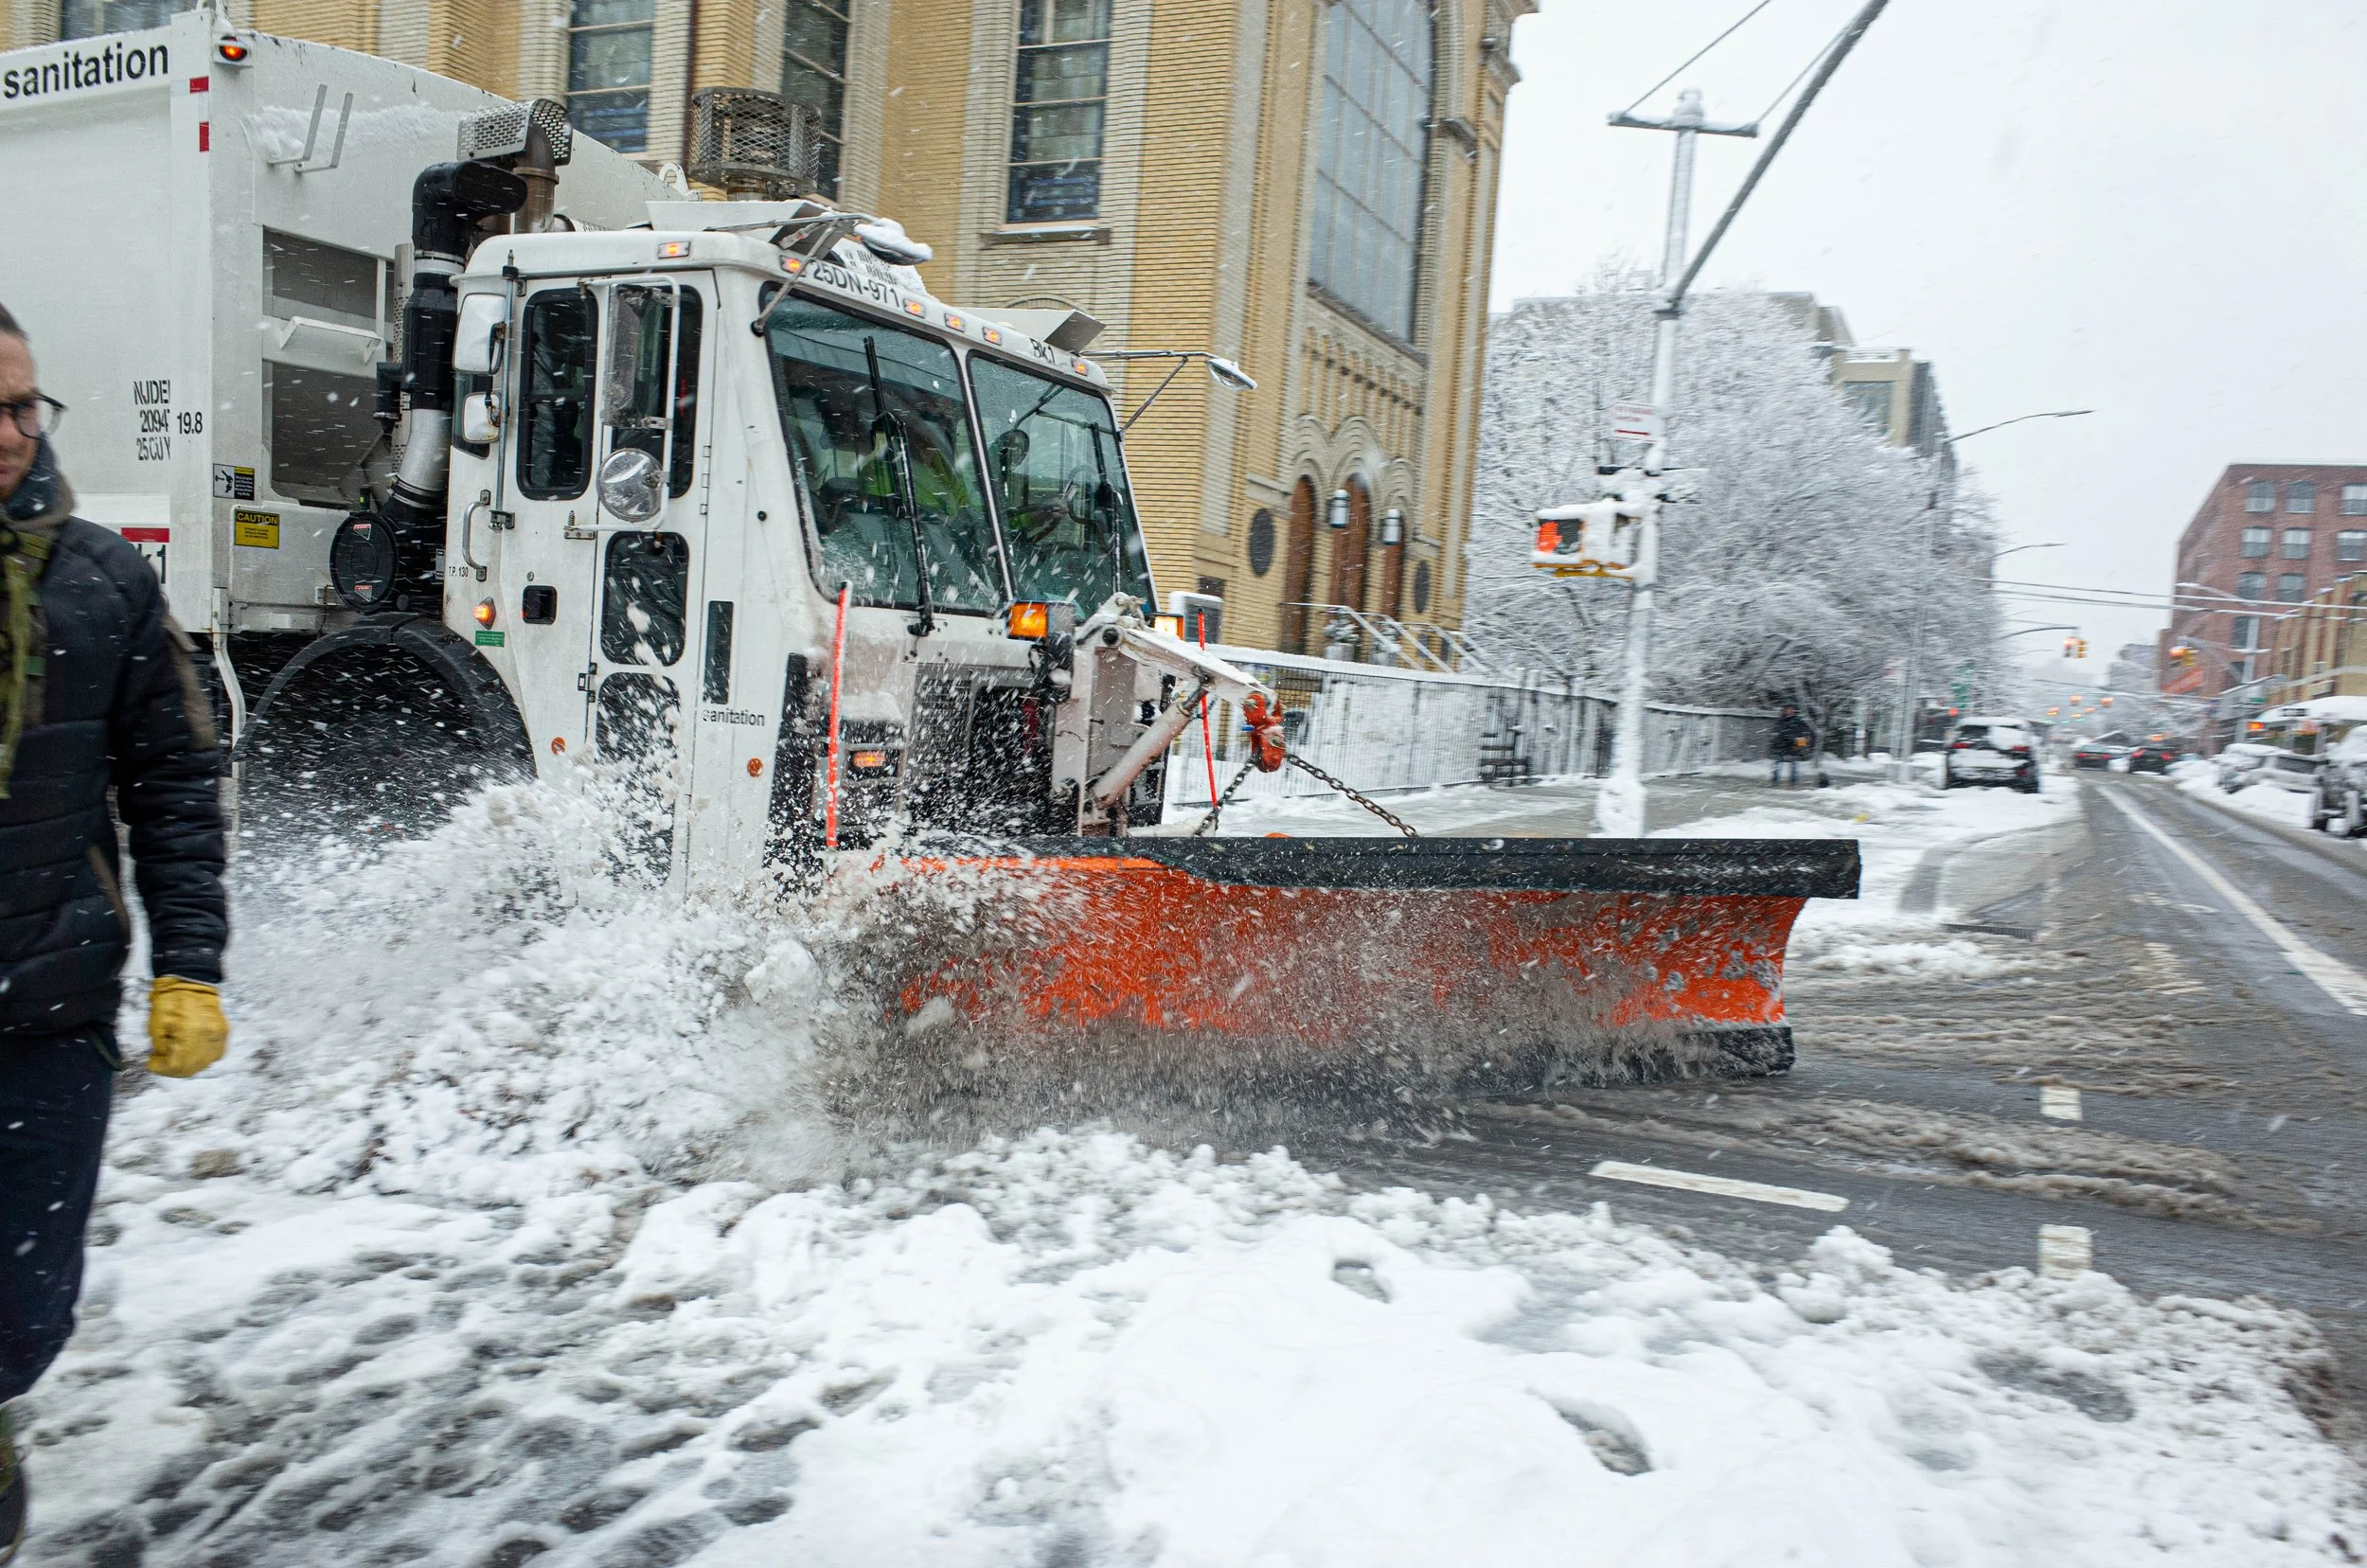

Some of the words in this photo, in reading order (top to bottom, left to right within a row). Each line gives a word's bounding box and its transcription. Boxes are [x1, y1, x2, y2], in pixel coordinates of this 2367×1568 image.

[3, 42, 169, 98] sanitation
[813, 261, 899, 308] 25DN-971
[176, 411, 204, 435] 19.8
[237, 512, 278, 526] CAUTION
